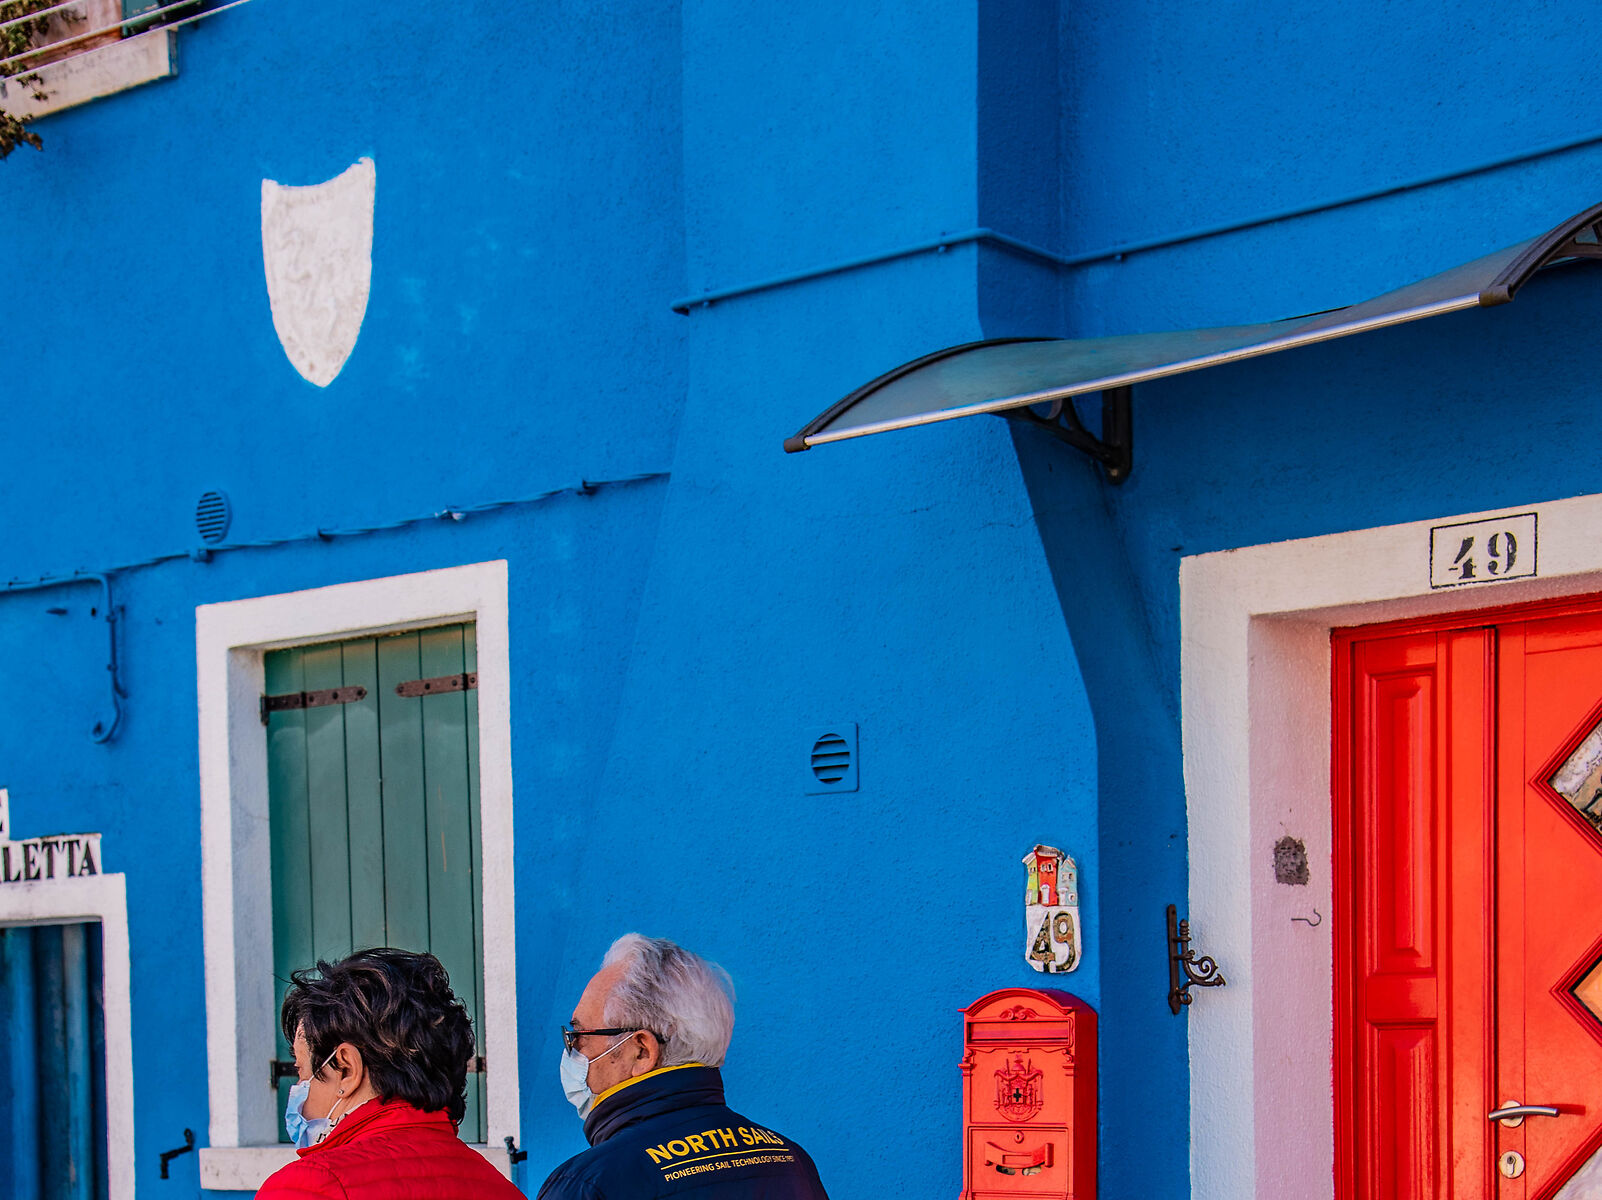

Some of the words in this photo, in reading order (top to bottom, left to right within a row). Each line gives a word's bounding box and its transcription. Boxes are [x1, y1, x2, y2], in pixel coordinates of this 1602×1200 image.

[1448, 531, 1517, 579] 49
[0, 839, 97, 882] LETTA
[1029, 911, 1076, 972] 49
[645, 1127, 738, 1164] NORTH
[738, 1126, 784, 1146] SAILS
[664, 1164, 715, 1182] PIONEERING
[715, 1161, 732, 1170] SAIL
[731, 1155, 771, 1168] TECHNOLOGY
